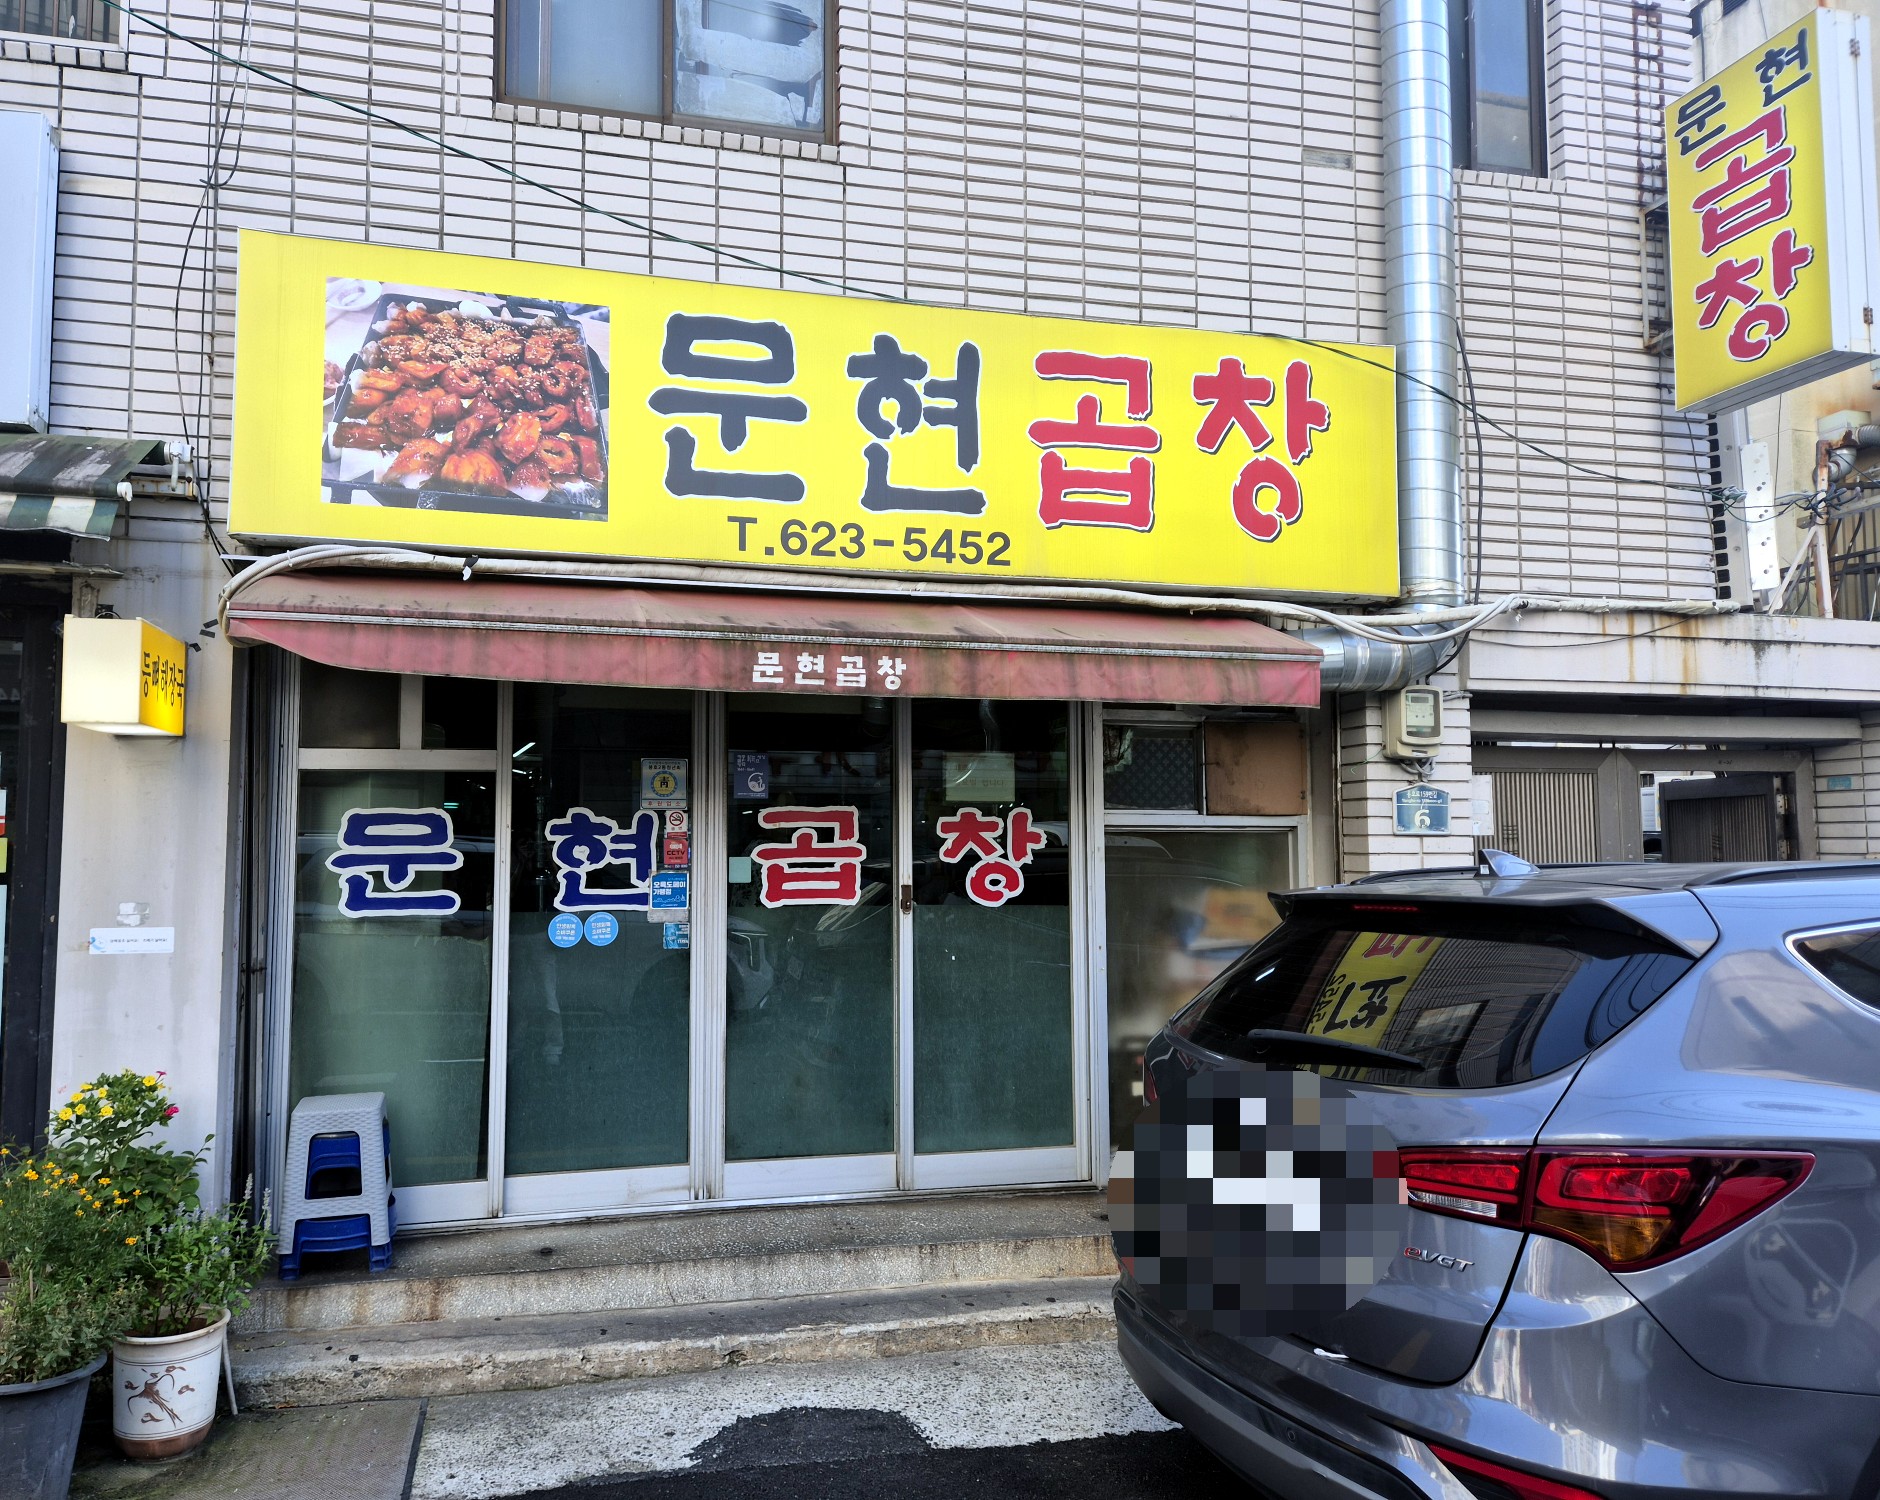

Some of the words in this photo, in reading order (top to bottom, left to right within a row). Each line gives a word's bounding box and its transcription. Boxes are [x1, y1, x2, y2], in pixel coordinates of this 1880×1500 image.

[1675, 27, 1814, 156] 문현
[1692, 106, 1815, 363] 곱창
[728, 515, 1012, 566] T.623-5452
[752, 651, 907, 690] 문현곱창
[1415, 809, 1431, 829] 6
